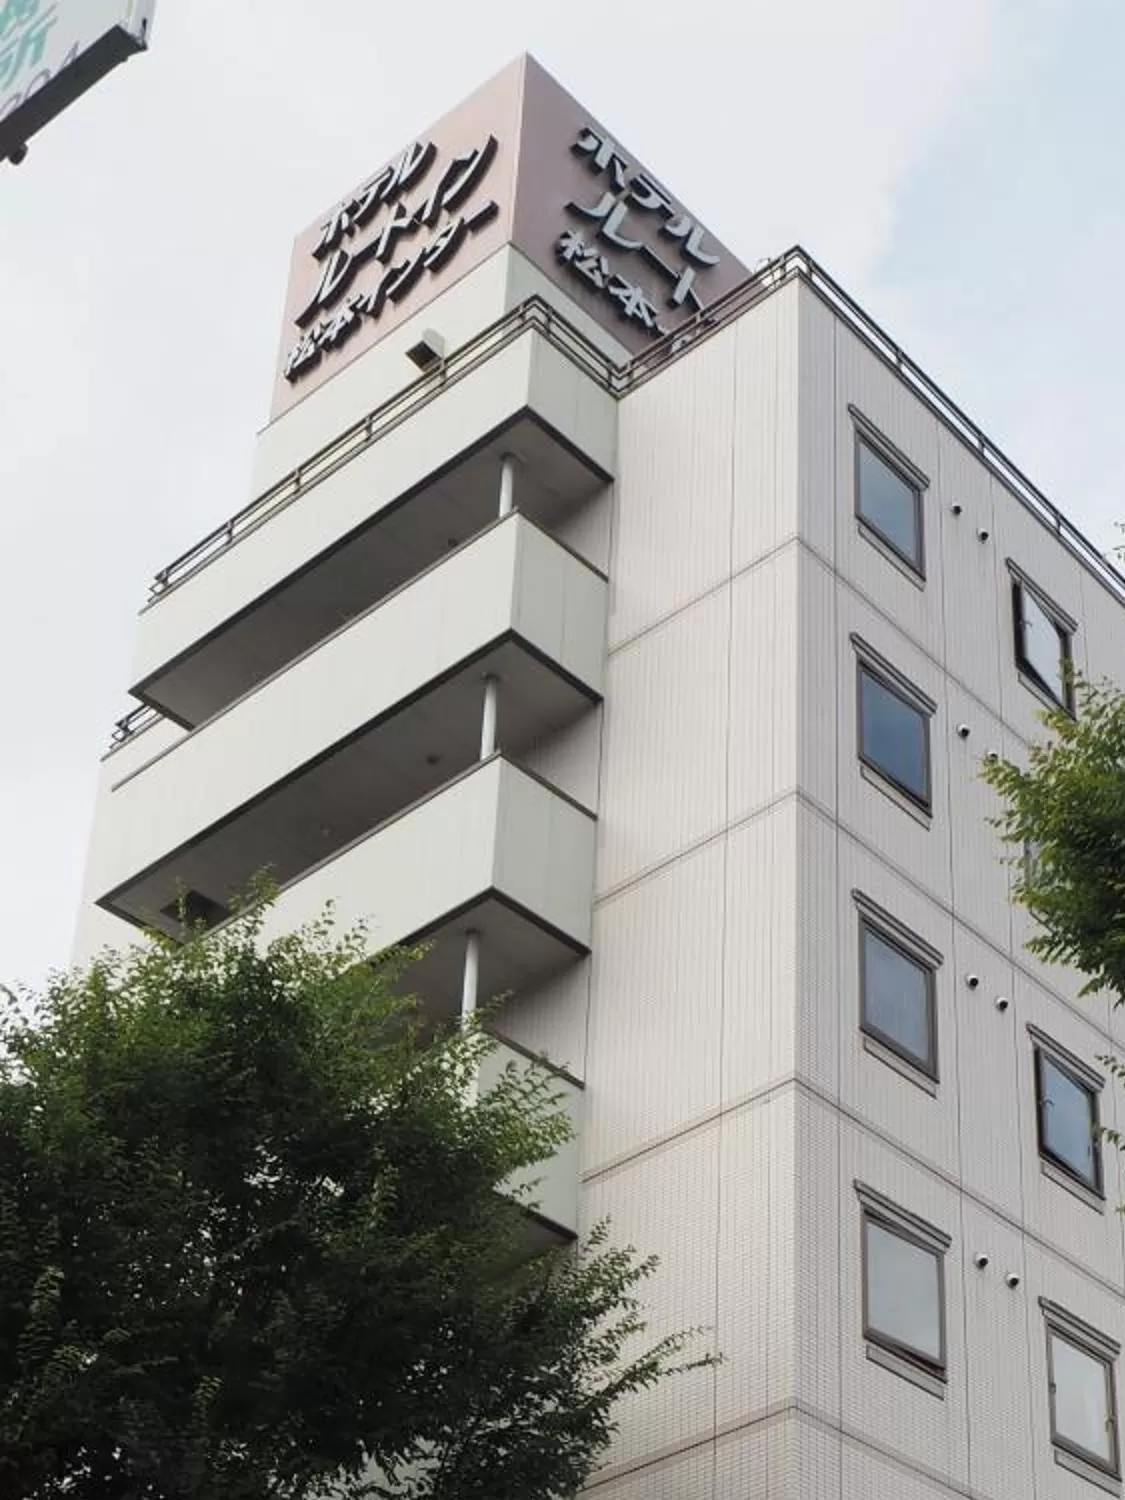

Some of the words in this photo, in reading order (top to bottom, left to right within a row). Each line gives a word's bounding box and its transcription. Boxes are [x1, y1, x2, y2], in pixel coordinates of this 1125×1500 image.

[295, 135, 499, 327] ルートイン
[313, 141, 437, 260] ホテル
[570, 127, 720, 266] ホテル
[284, 200, 500, 383] 松本インター
